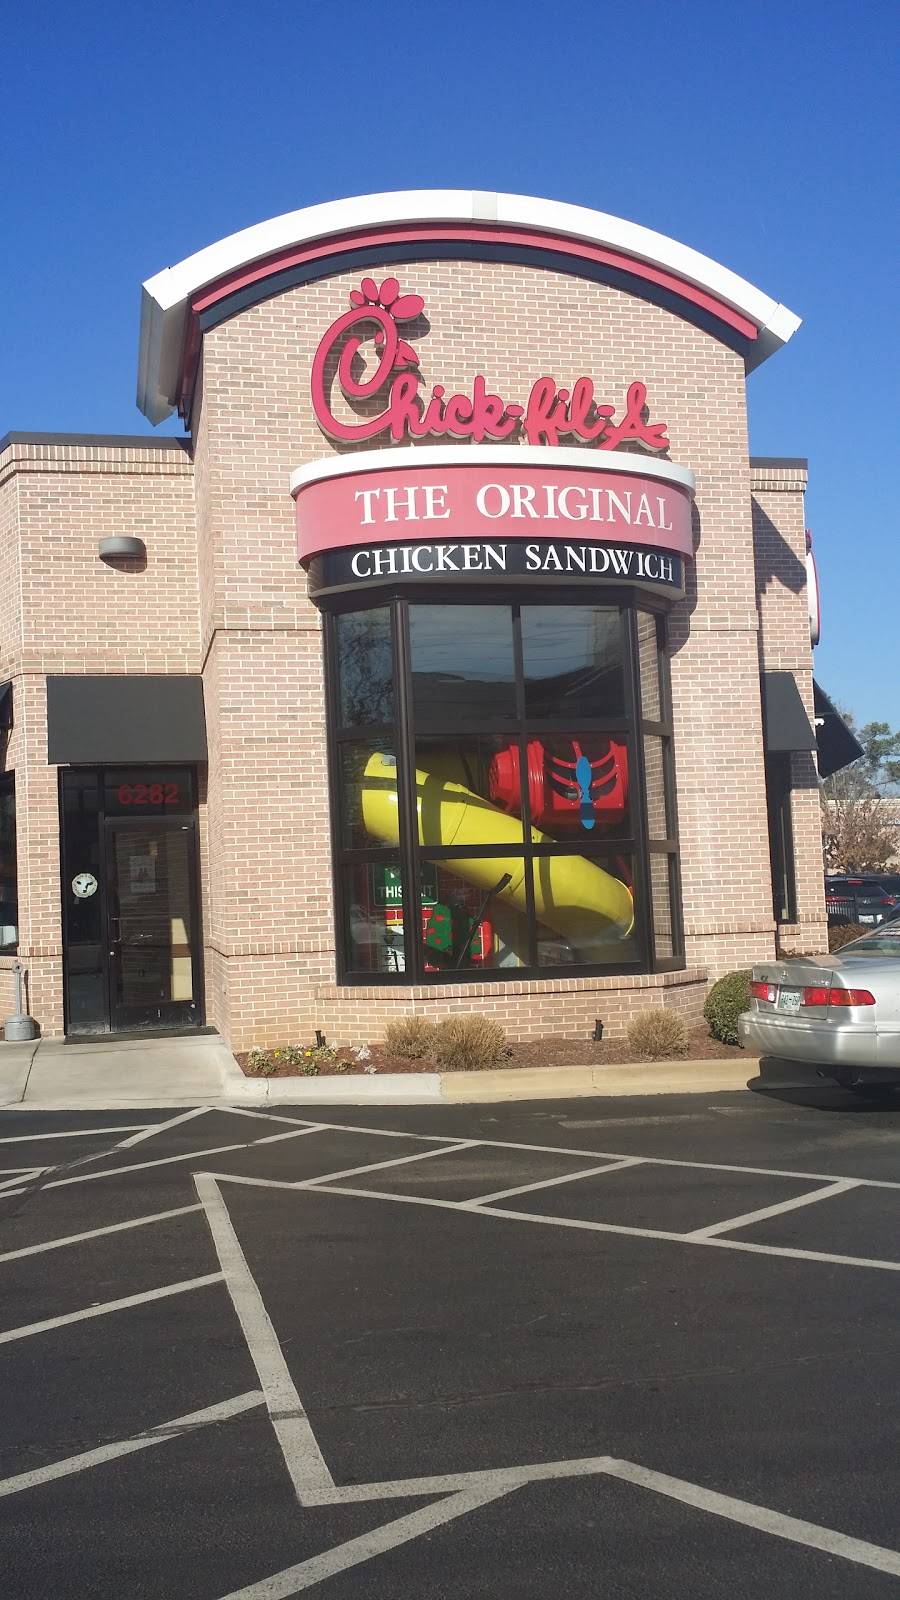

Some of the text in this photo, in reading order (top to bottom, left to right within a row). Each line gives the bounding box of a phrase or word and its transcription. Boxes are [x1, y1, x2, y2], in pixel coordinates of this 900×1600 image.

[311, 277, 671, 451] Chick-fil-A
[355, 484, 673, 530] THE ORIGINAL
[351, 544, 674, 582] CHICKEN SANDWICH
[118, 783, 177, 805] 6282
